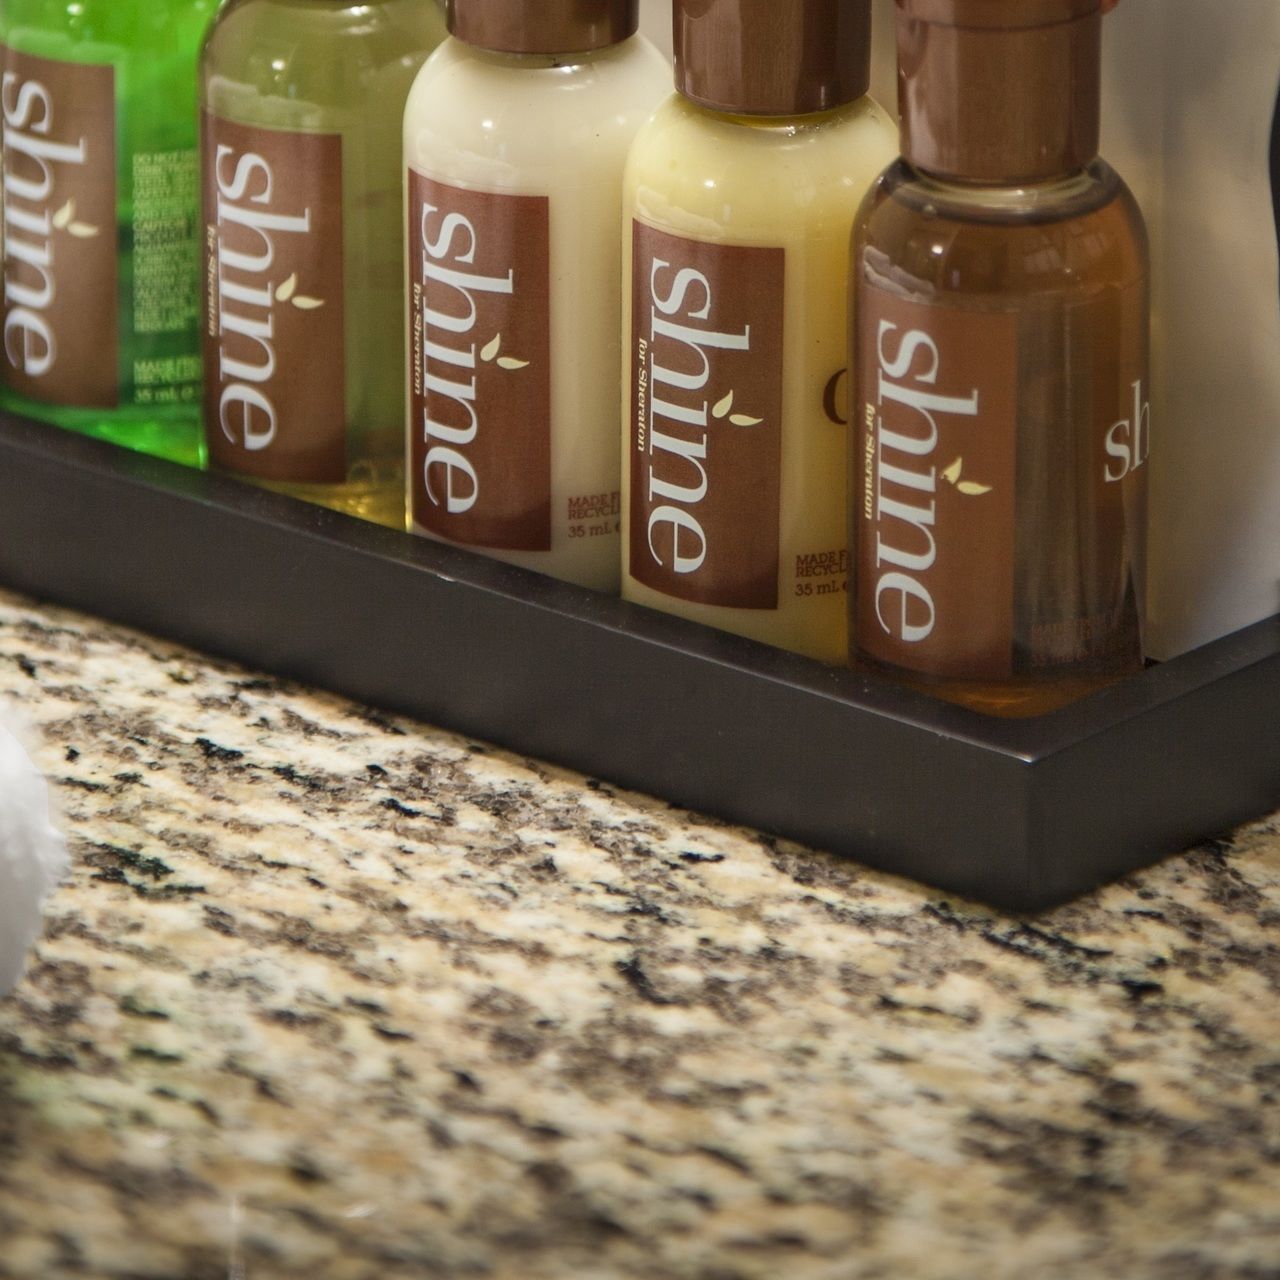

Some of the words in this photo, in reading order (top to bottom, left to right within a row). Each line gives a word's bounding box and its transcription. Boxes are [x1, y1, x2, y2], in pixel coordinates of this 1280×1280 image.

[2, 72, 86, 377] shine
[216, 144, 310, 451] shine
[421, 202, 513, 514] shine
[638, 337, 648, 365] for
[638, 367, 648, 452] Sheraton
[648, 257, 750, 574] shine
[865, 402, 876, 430] for
[864, 433, 876, 520] Sheraton
[875, 319, 978, 643] shine
[568, 494, 608, 508] MADE
[568, 504, 620, 520] RECYCL
[568, 525, 585, 538] 35
[590, 521, 612, 536] mL
[796, 551, 836, 565] MADE
[796, 562, 848, 578] RECYCL
[795, 582, 813, 597] 35
[816, 580, 839, 595] mL
